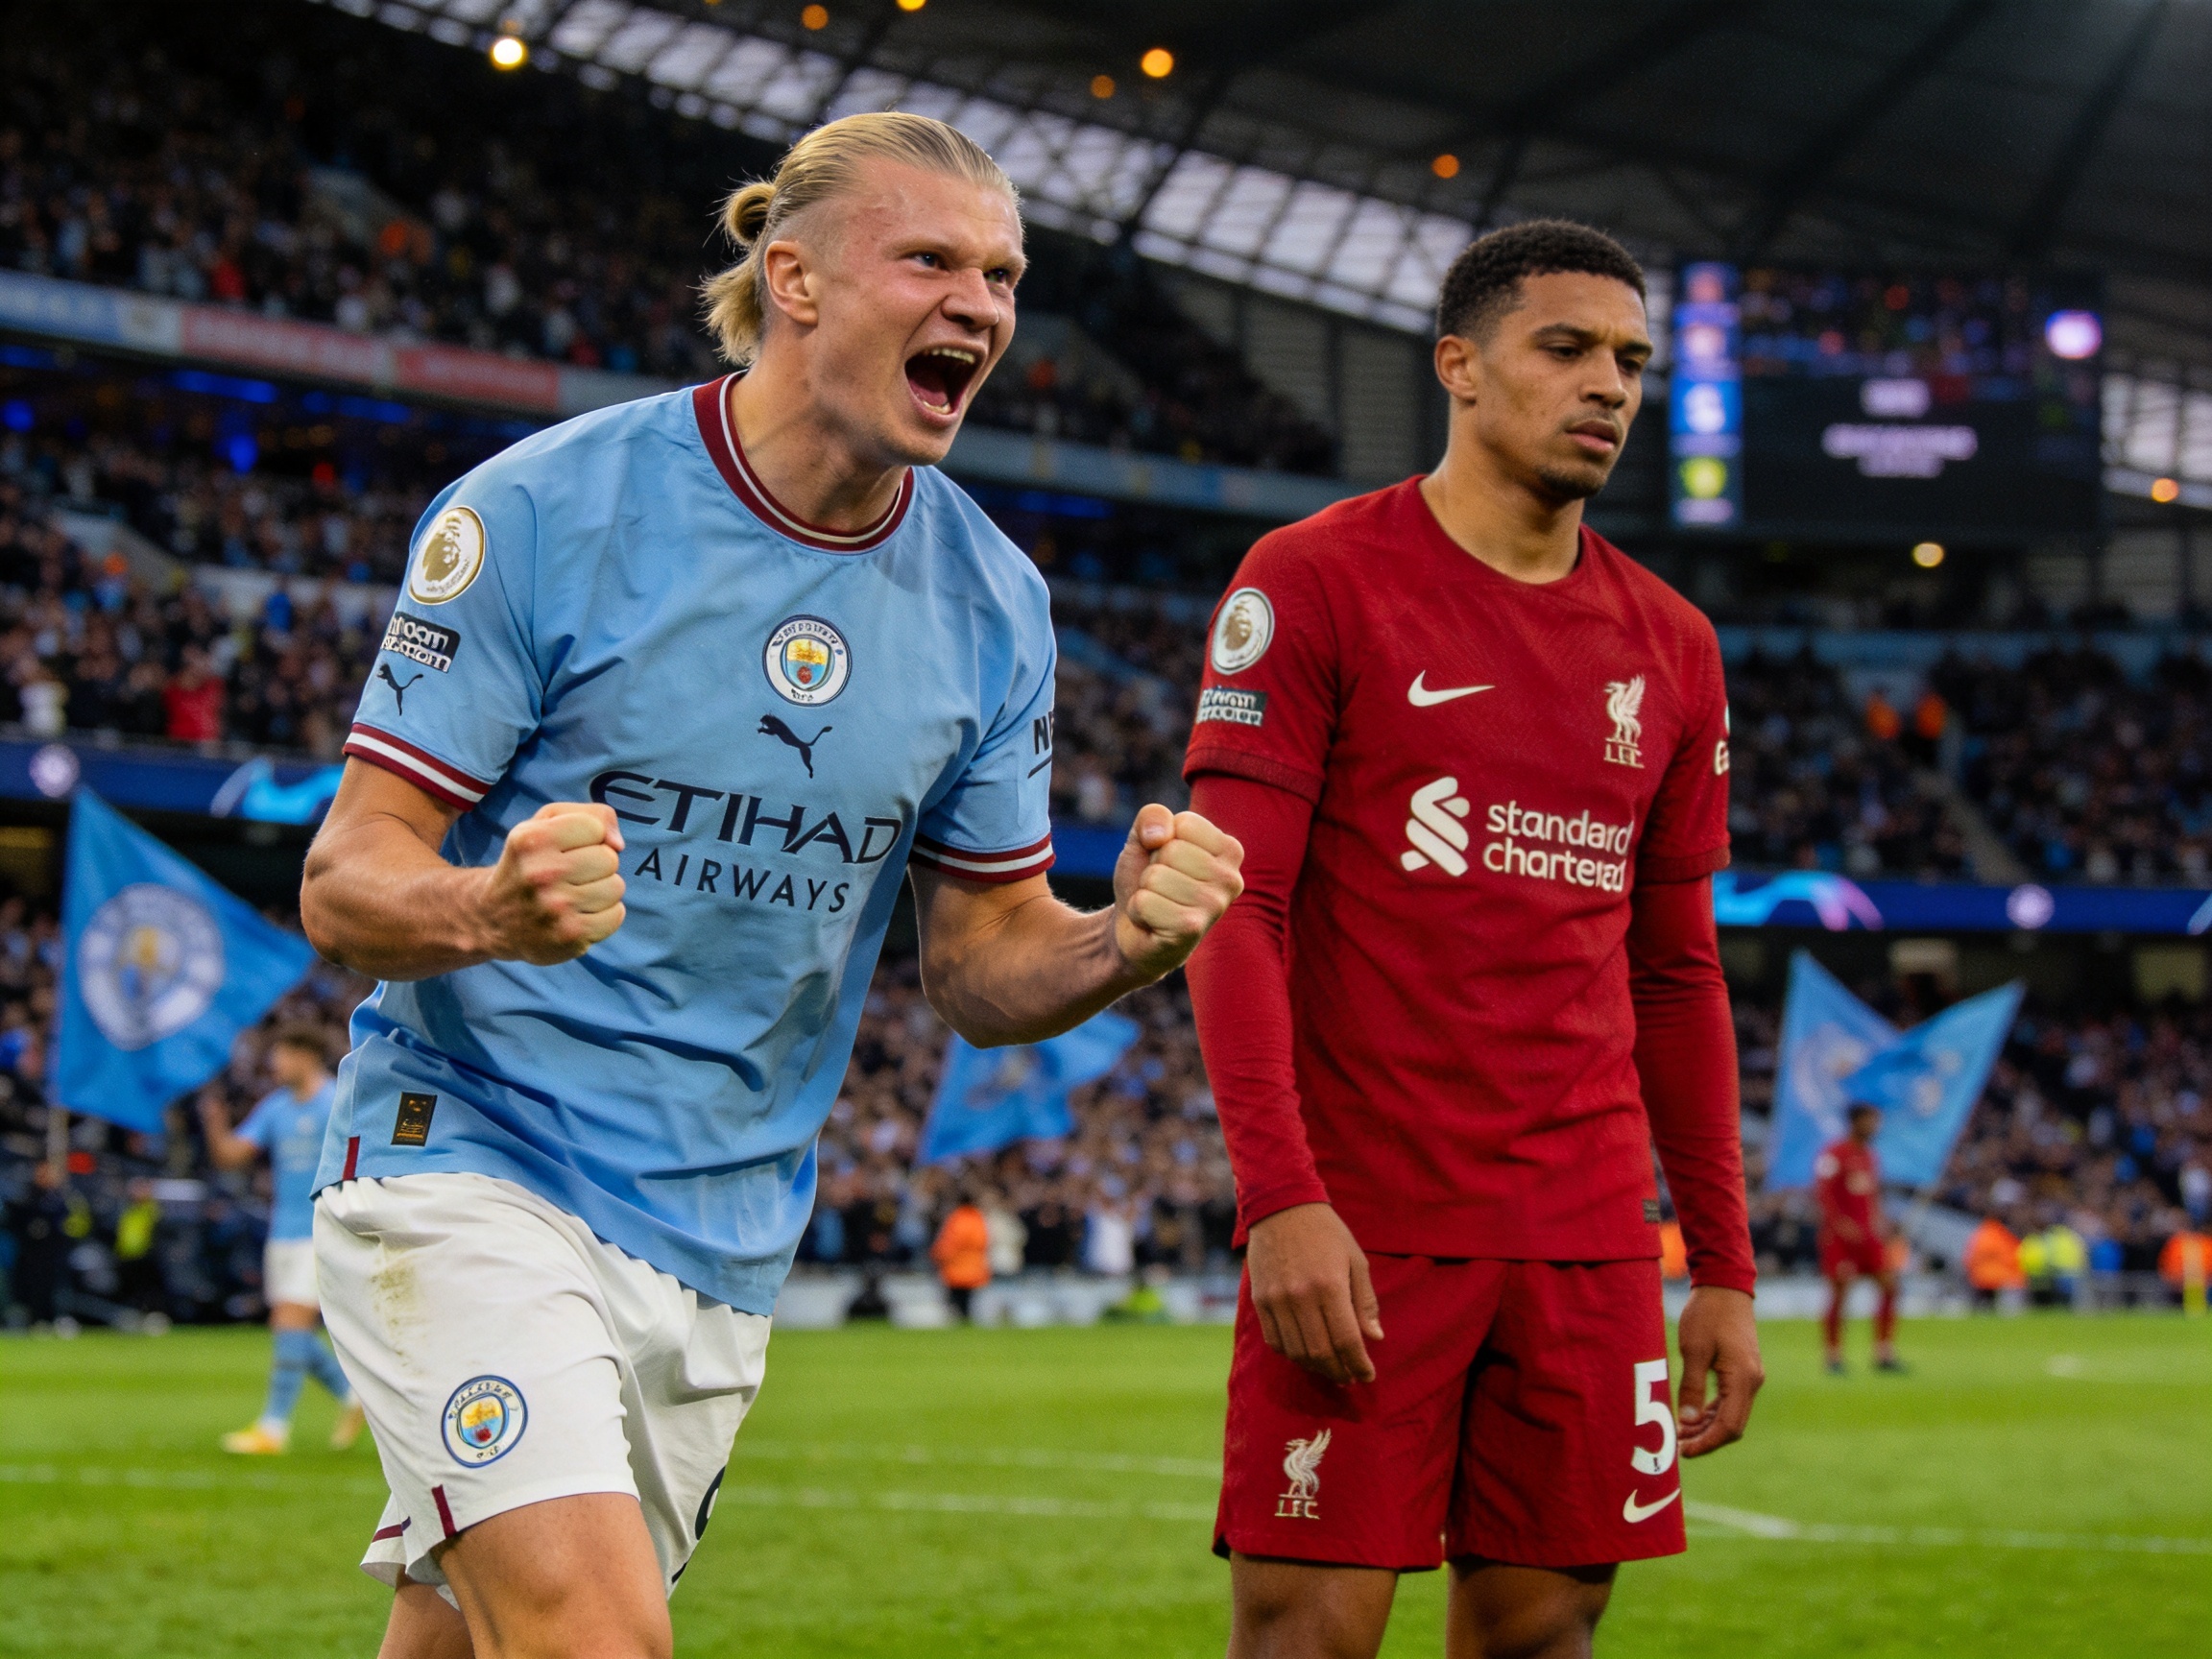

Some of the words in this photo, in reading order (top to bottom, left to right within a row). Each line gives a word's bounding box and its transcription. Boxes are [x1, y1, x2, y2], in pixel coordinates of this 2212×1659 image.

[589, 770, 902, 865] ETIHAD
[1485, 800, 1635, 856] standard
[634, 847, 850, 913] AIRWAYS
[1630, 1358, 1677, 1476] 5
